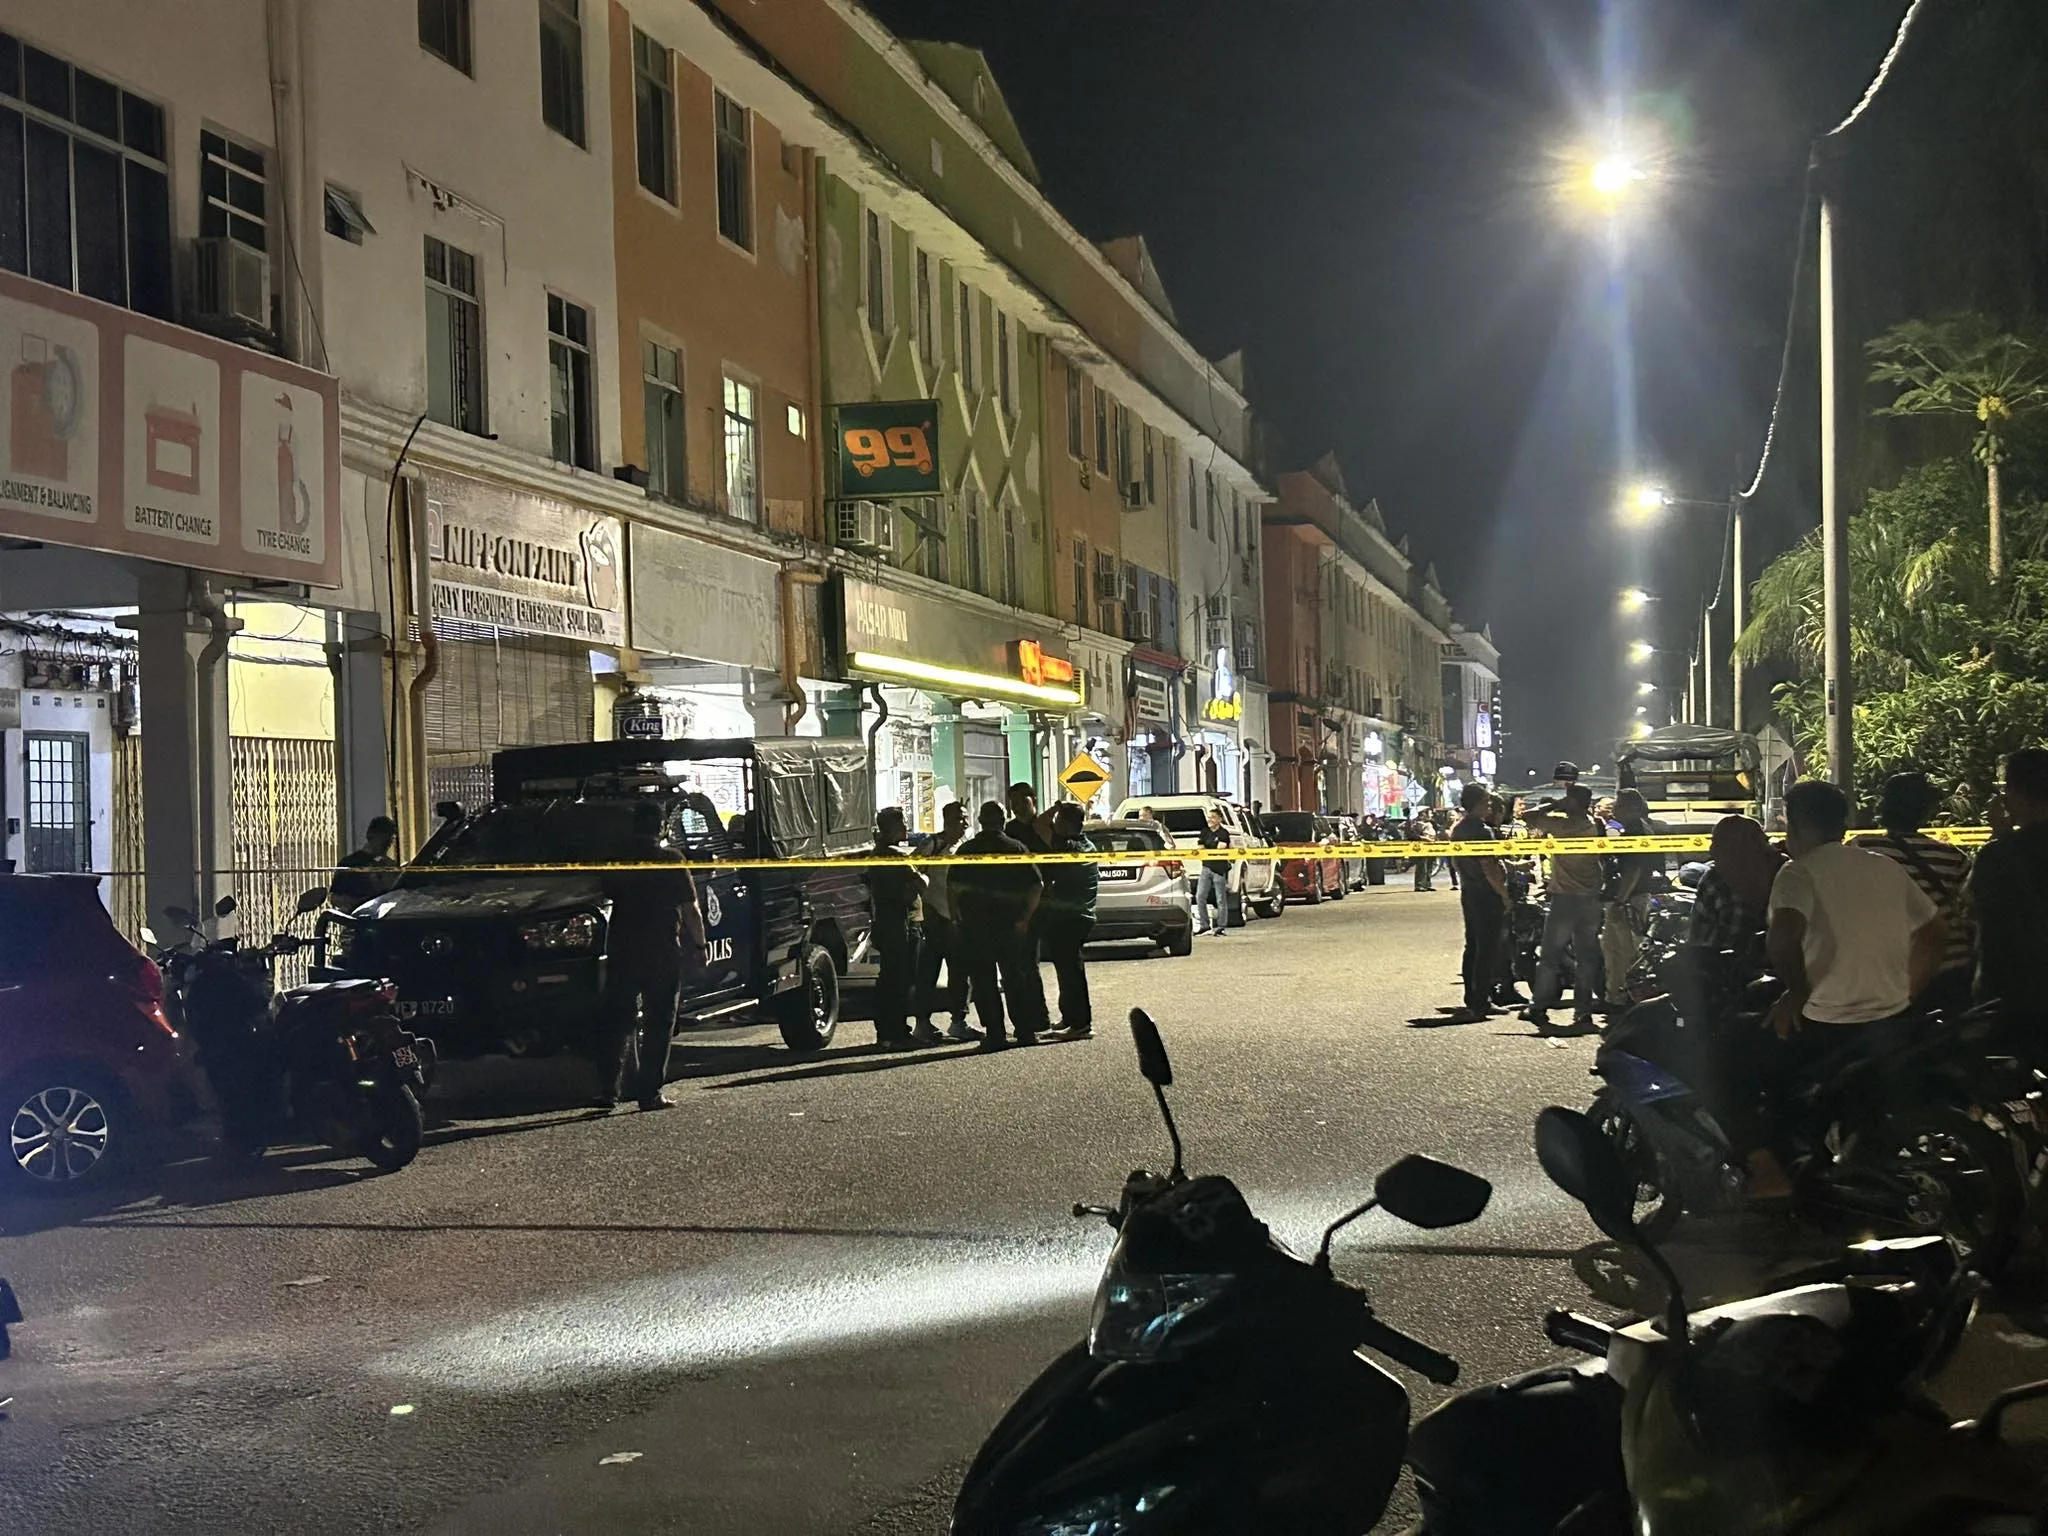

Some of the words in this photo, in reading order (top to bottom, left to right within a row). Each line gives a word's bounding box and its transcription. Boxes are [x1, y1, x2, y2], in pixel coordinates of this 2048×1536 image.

[844, 426, 933, 477] 99
[47, 487, 92, 514] BALANCING
[135, 506, 174, 529] BATTERY
[175, 513, 212, 537] CHANGE
[256, 529, 277, 548] TYRE
[278, 533, 310, 555] CHANGE
[432, 582, 460, 613] YALTY
[856, 599, 888, 638] PASAR
[630, 718, 660, 733] King
[705, 937, 733, 957] OLIS
